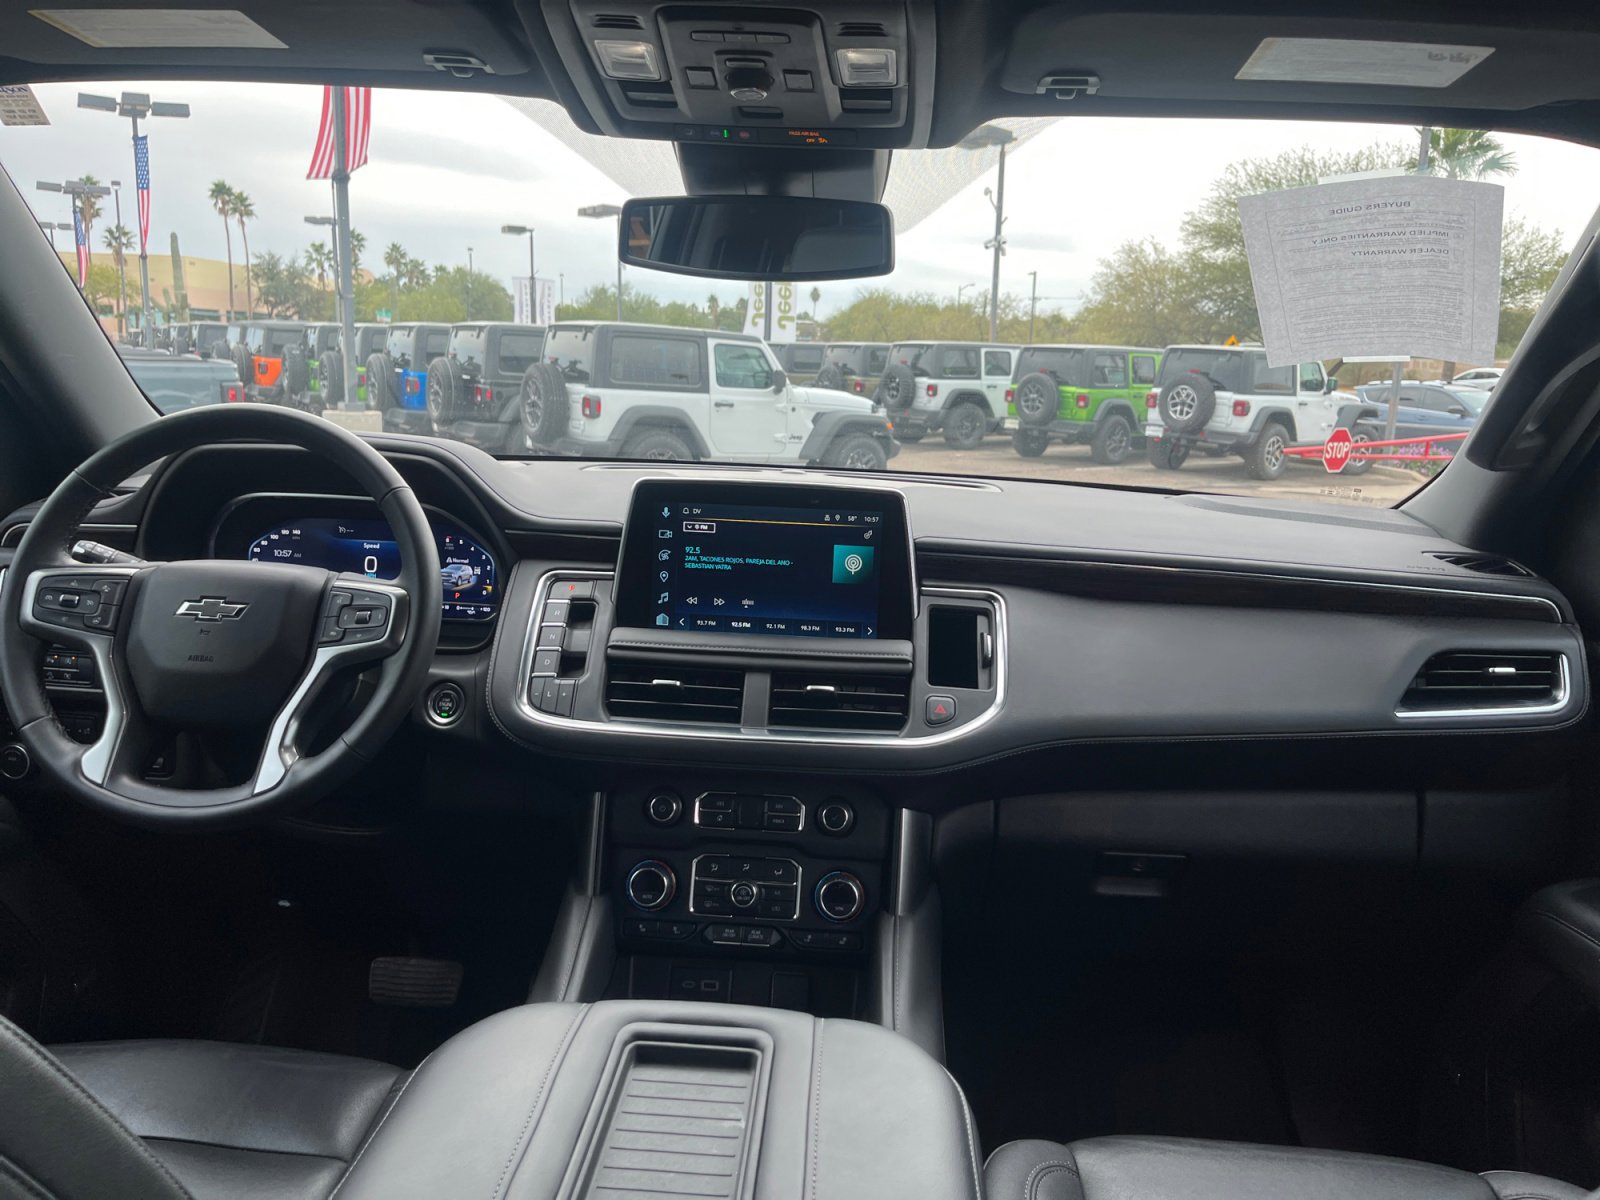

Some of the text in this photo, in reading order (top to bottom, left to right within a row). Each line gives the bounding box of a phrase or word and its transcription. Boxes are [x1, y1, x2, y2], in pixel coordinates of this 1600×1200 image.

[1325, 442, 1350, 459] STOP
[274, 549, 292, 557] 10:57
[685, 546, 701, 554] 92.5
[364, 555, 378, 573] 0
[544, 658, 551, 666] D
